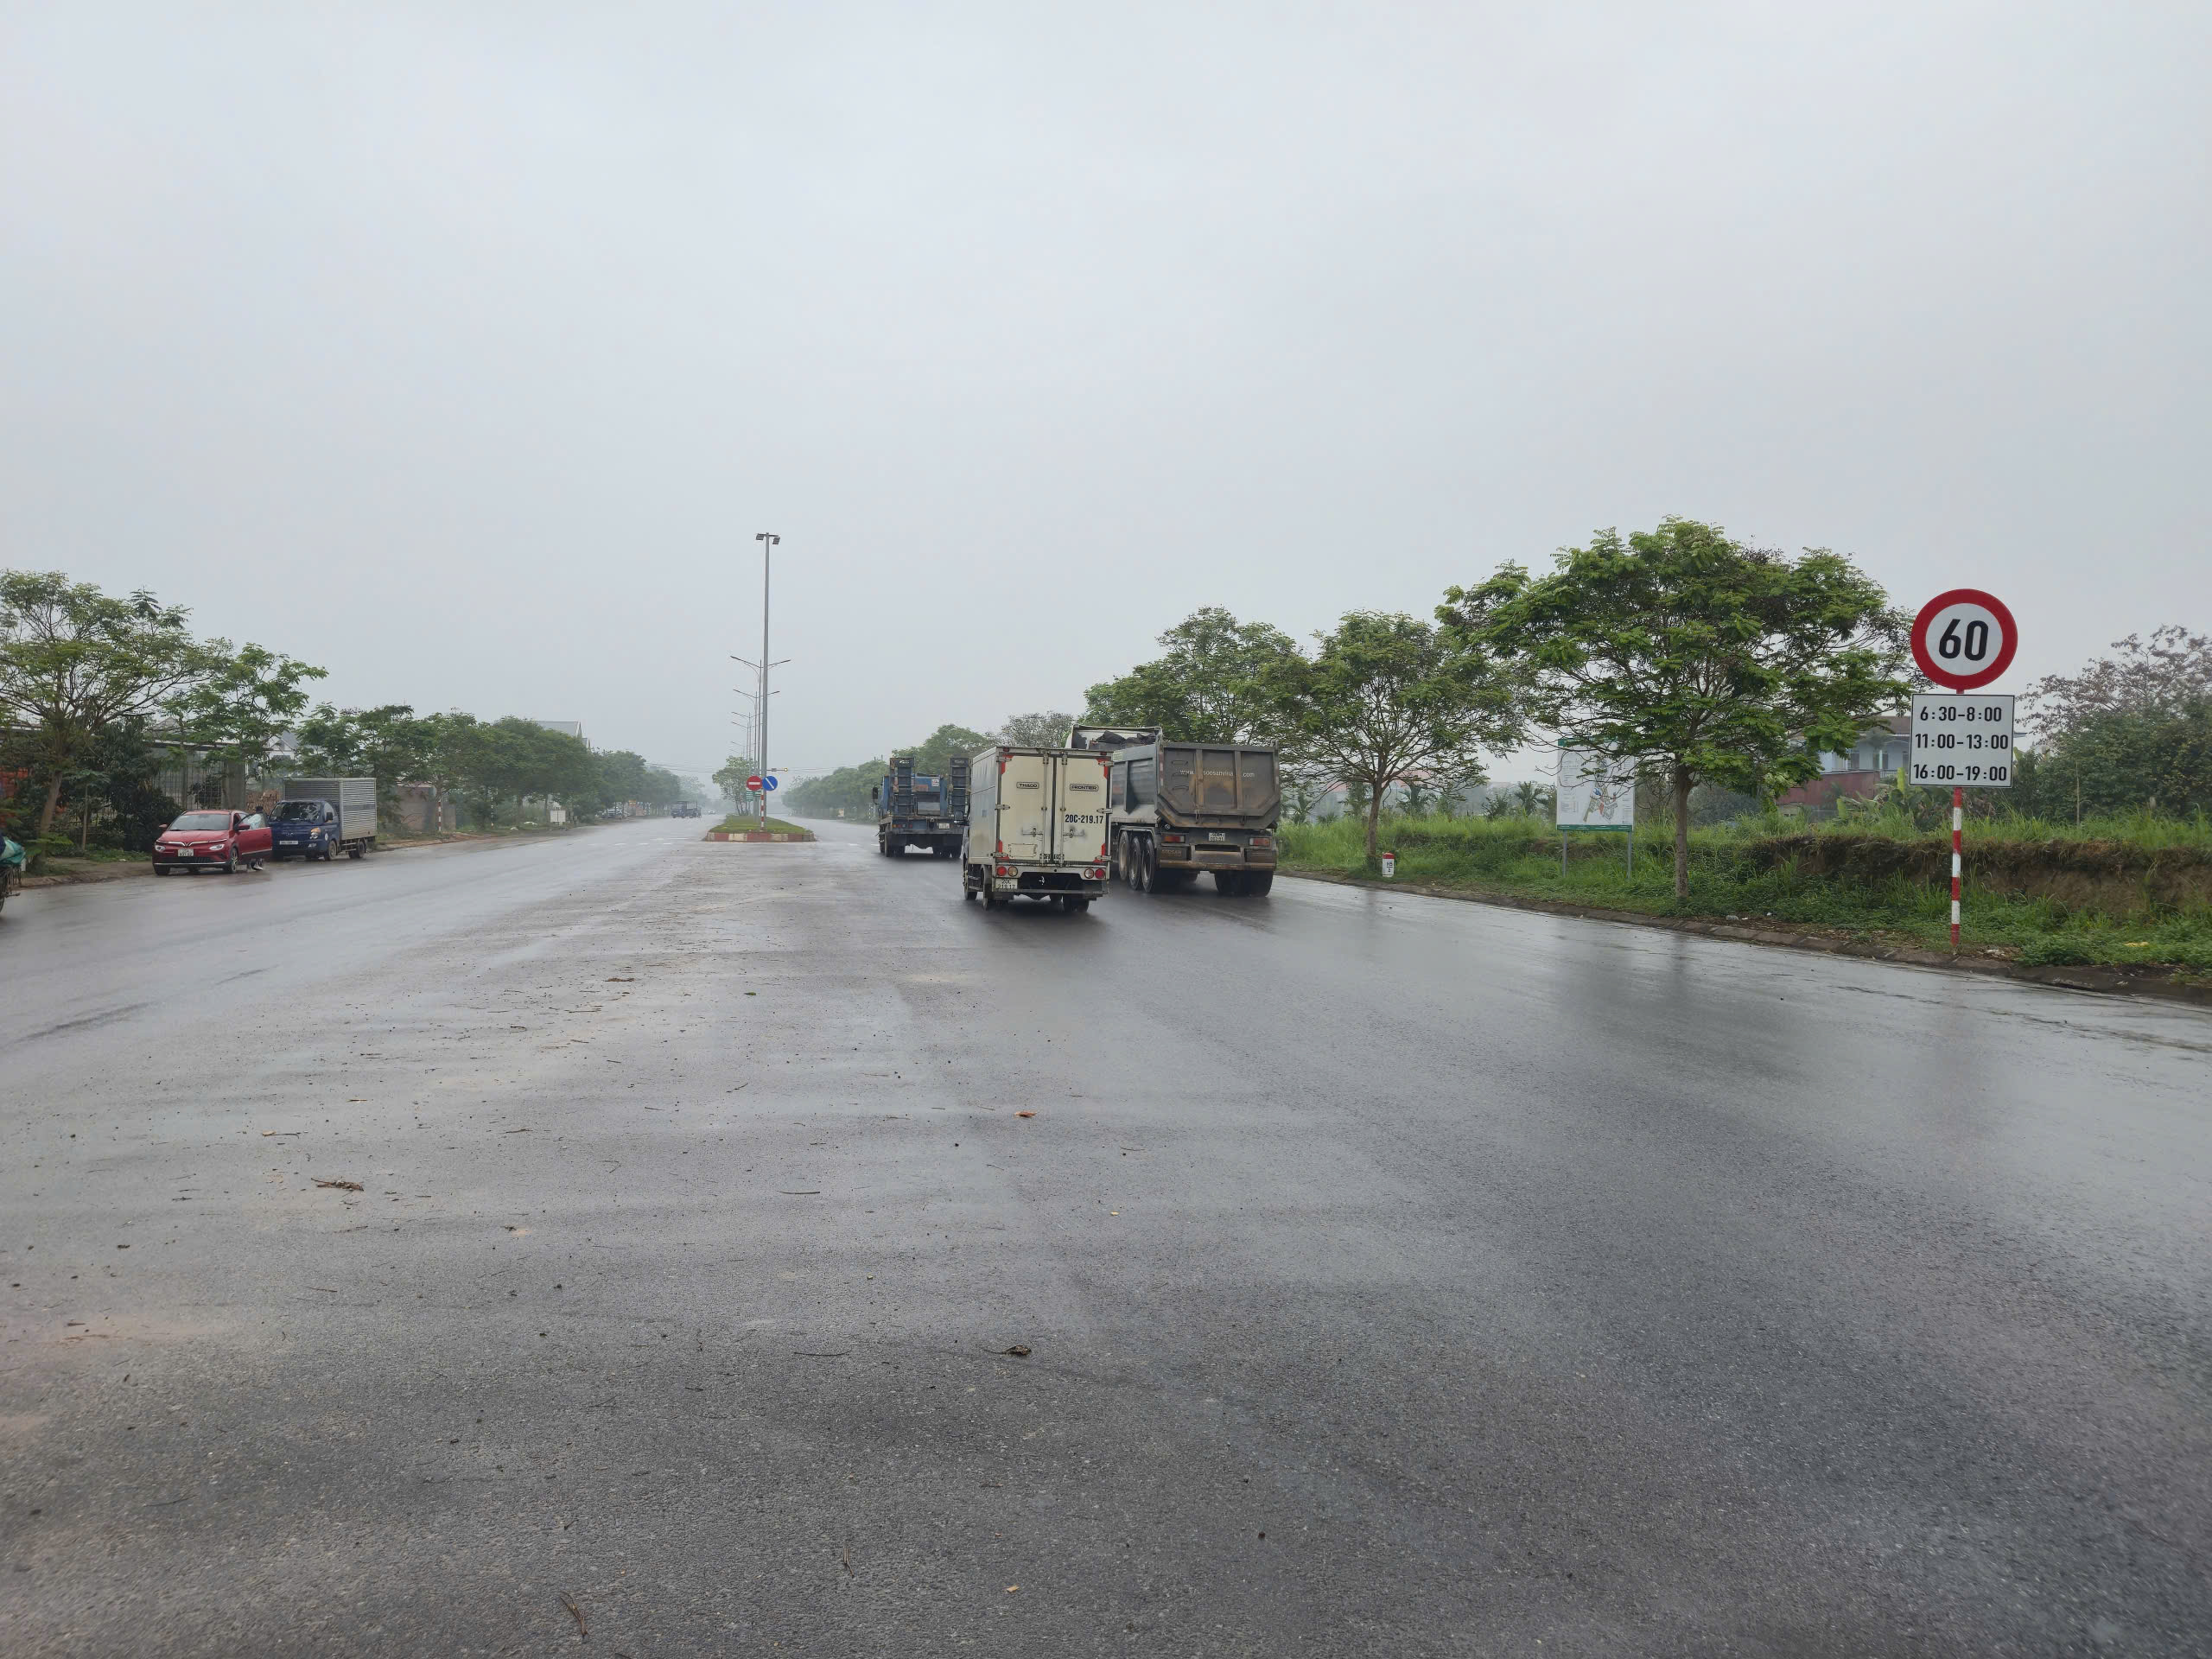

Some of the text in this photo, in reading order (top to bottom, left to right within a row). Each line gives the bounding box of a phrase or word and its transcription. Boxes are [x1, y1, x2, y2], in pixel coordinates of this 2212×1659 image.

[1938, 618, 1989, 661] 60
[1920, 706, 2002, 722] 6:30-8:00
[1915, 734, 2009, 749] 11:00-13:00
[1913, 764, 2007, 781] 16:00-19:00
[1065, 814, 1104, 824] 20C-219.17
